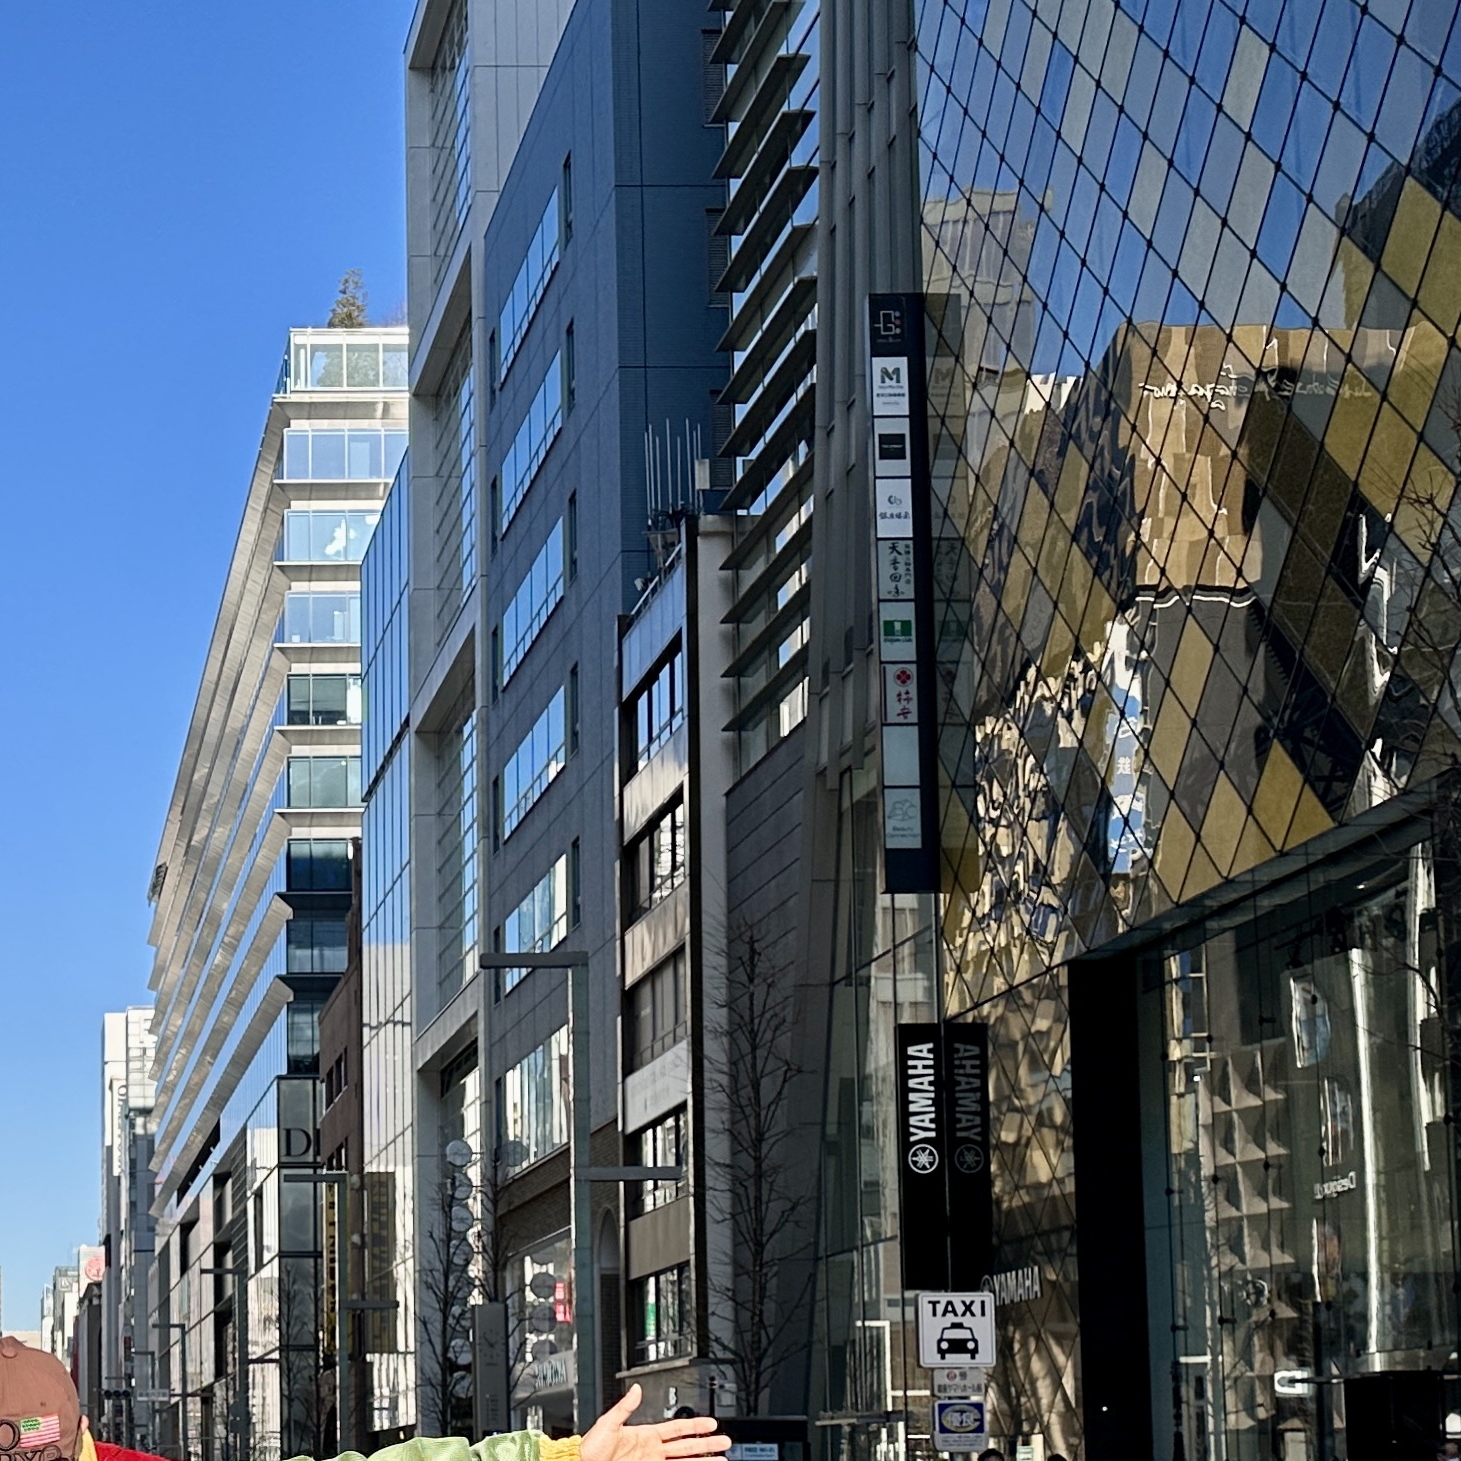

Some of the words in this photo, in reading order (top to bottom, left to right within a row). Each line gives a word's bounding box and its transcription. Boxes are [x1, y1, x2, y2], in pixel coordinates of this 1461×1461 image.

[907, 1042, 937, 1142] YAMAHA
[993, 1265, 1041, 1306] YAMAHA
[928, 1300, 986, 1317] TAXI
